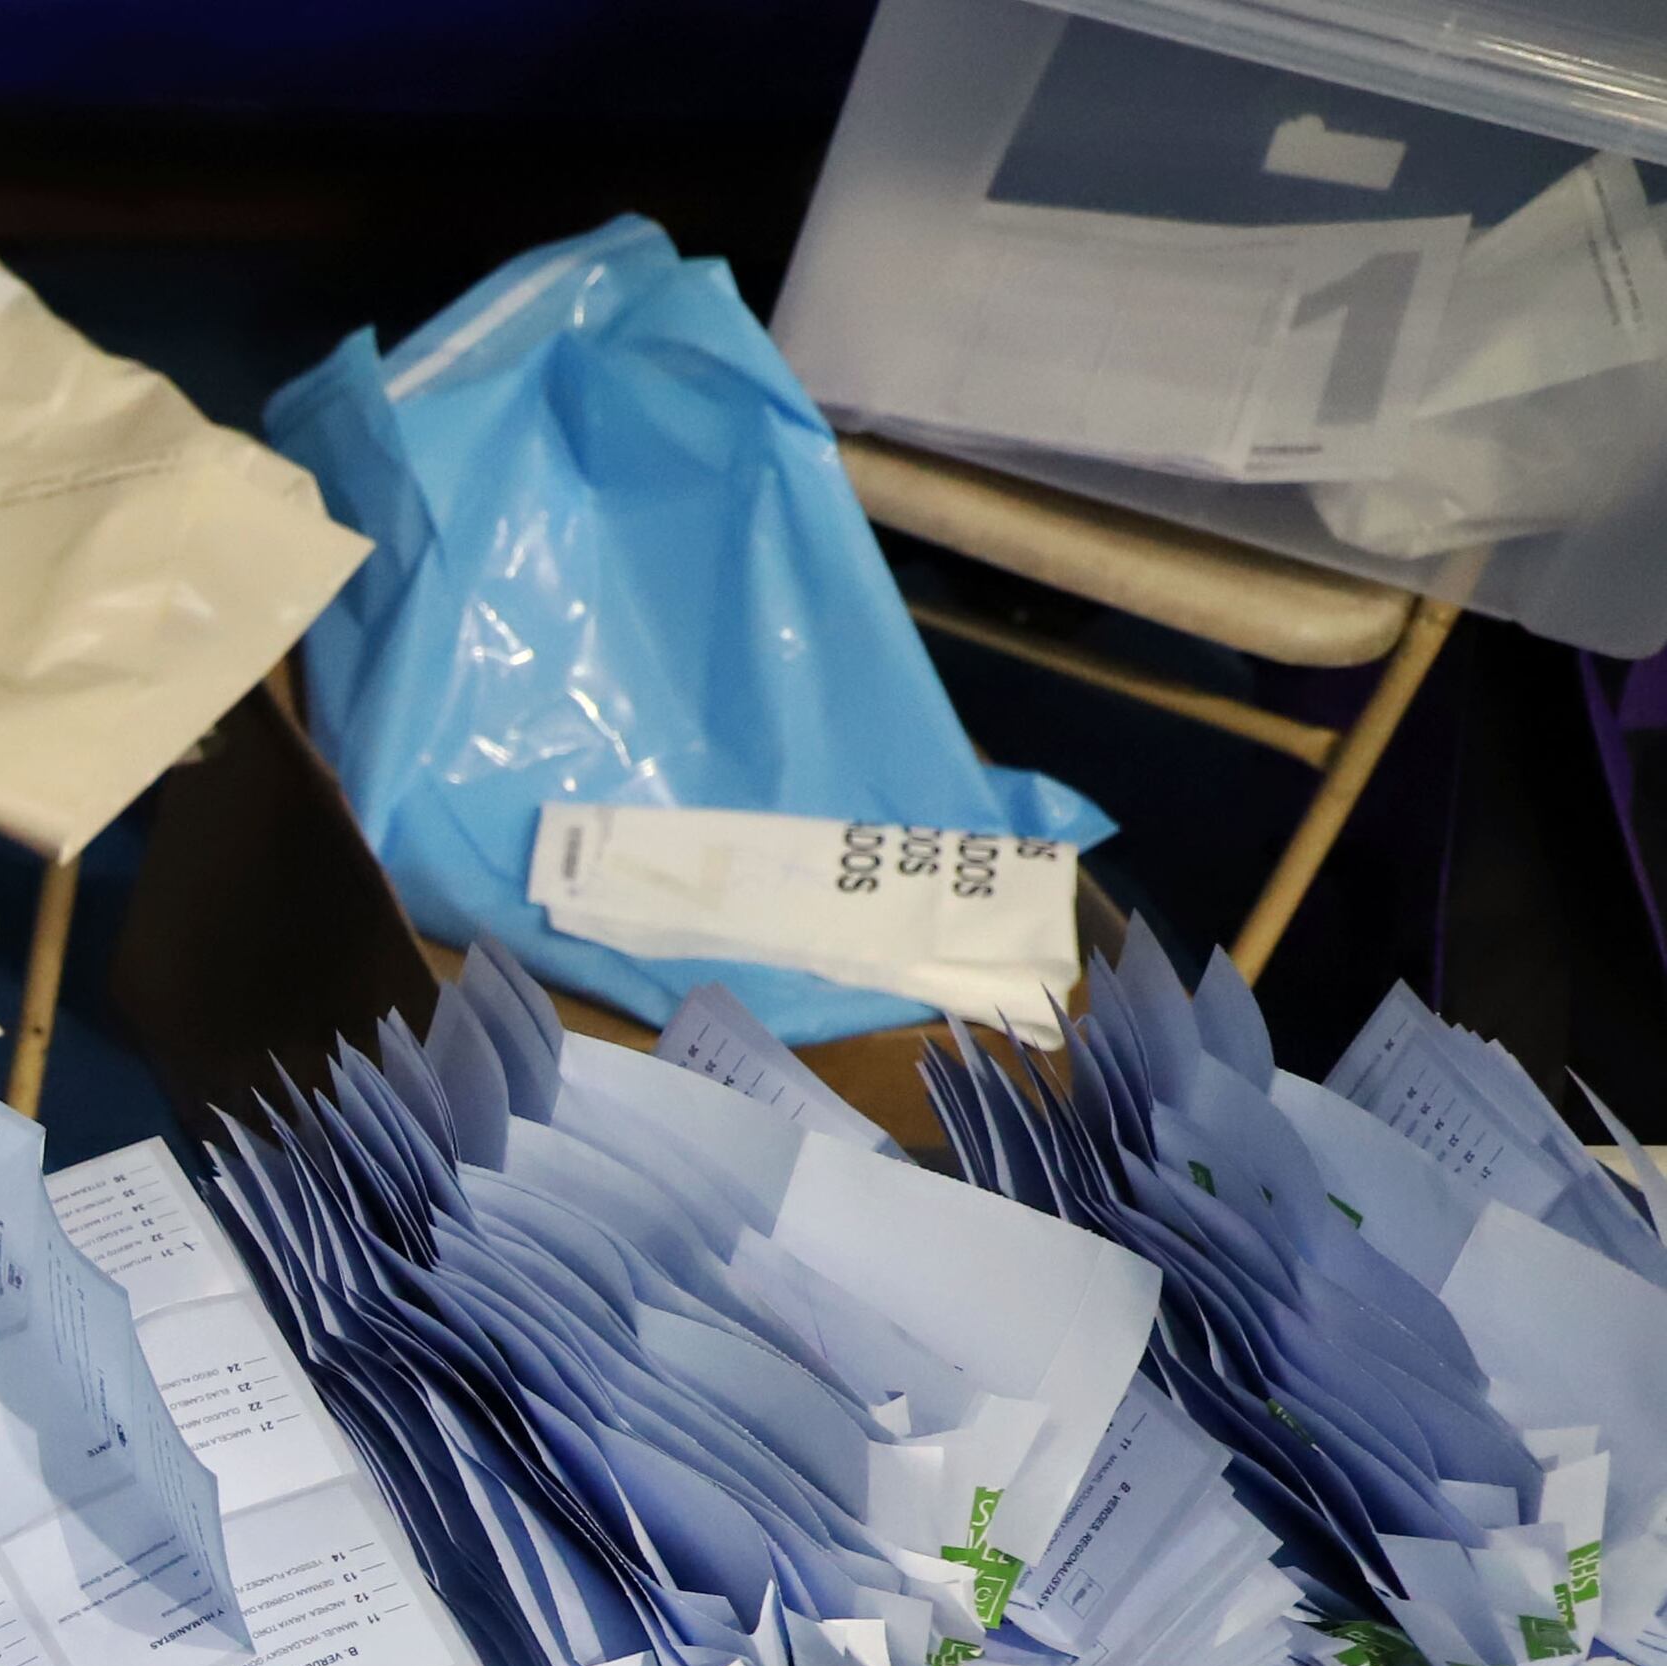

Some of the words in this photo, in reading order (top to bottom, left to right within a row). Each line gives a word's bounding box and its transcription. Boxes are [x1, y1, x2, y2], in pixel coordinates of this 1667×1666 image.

[227, 1363, 241, 1374] 24
[248, 1401, 263, 1412] 22
[1120, 1437, 1132, 1450] 11
[331, 1551, 346, 1563] 14
[1040, 1533, 1092, 1601] REGIONALISTAS
[1569, 1550, 1599, 1593] SER
[343, 1571, 357, 1583] 13
[354, 1592, 369, 1604] 12
[366, 1612, 381, 1624] 11
[149, 1612, 216, 1650] HUMANISTAS
[344, 1646, 358, 1657] B.
